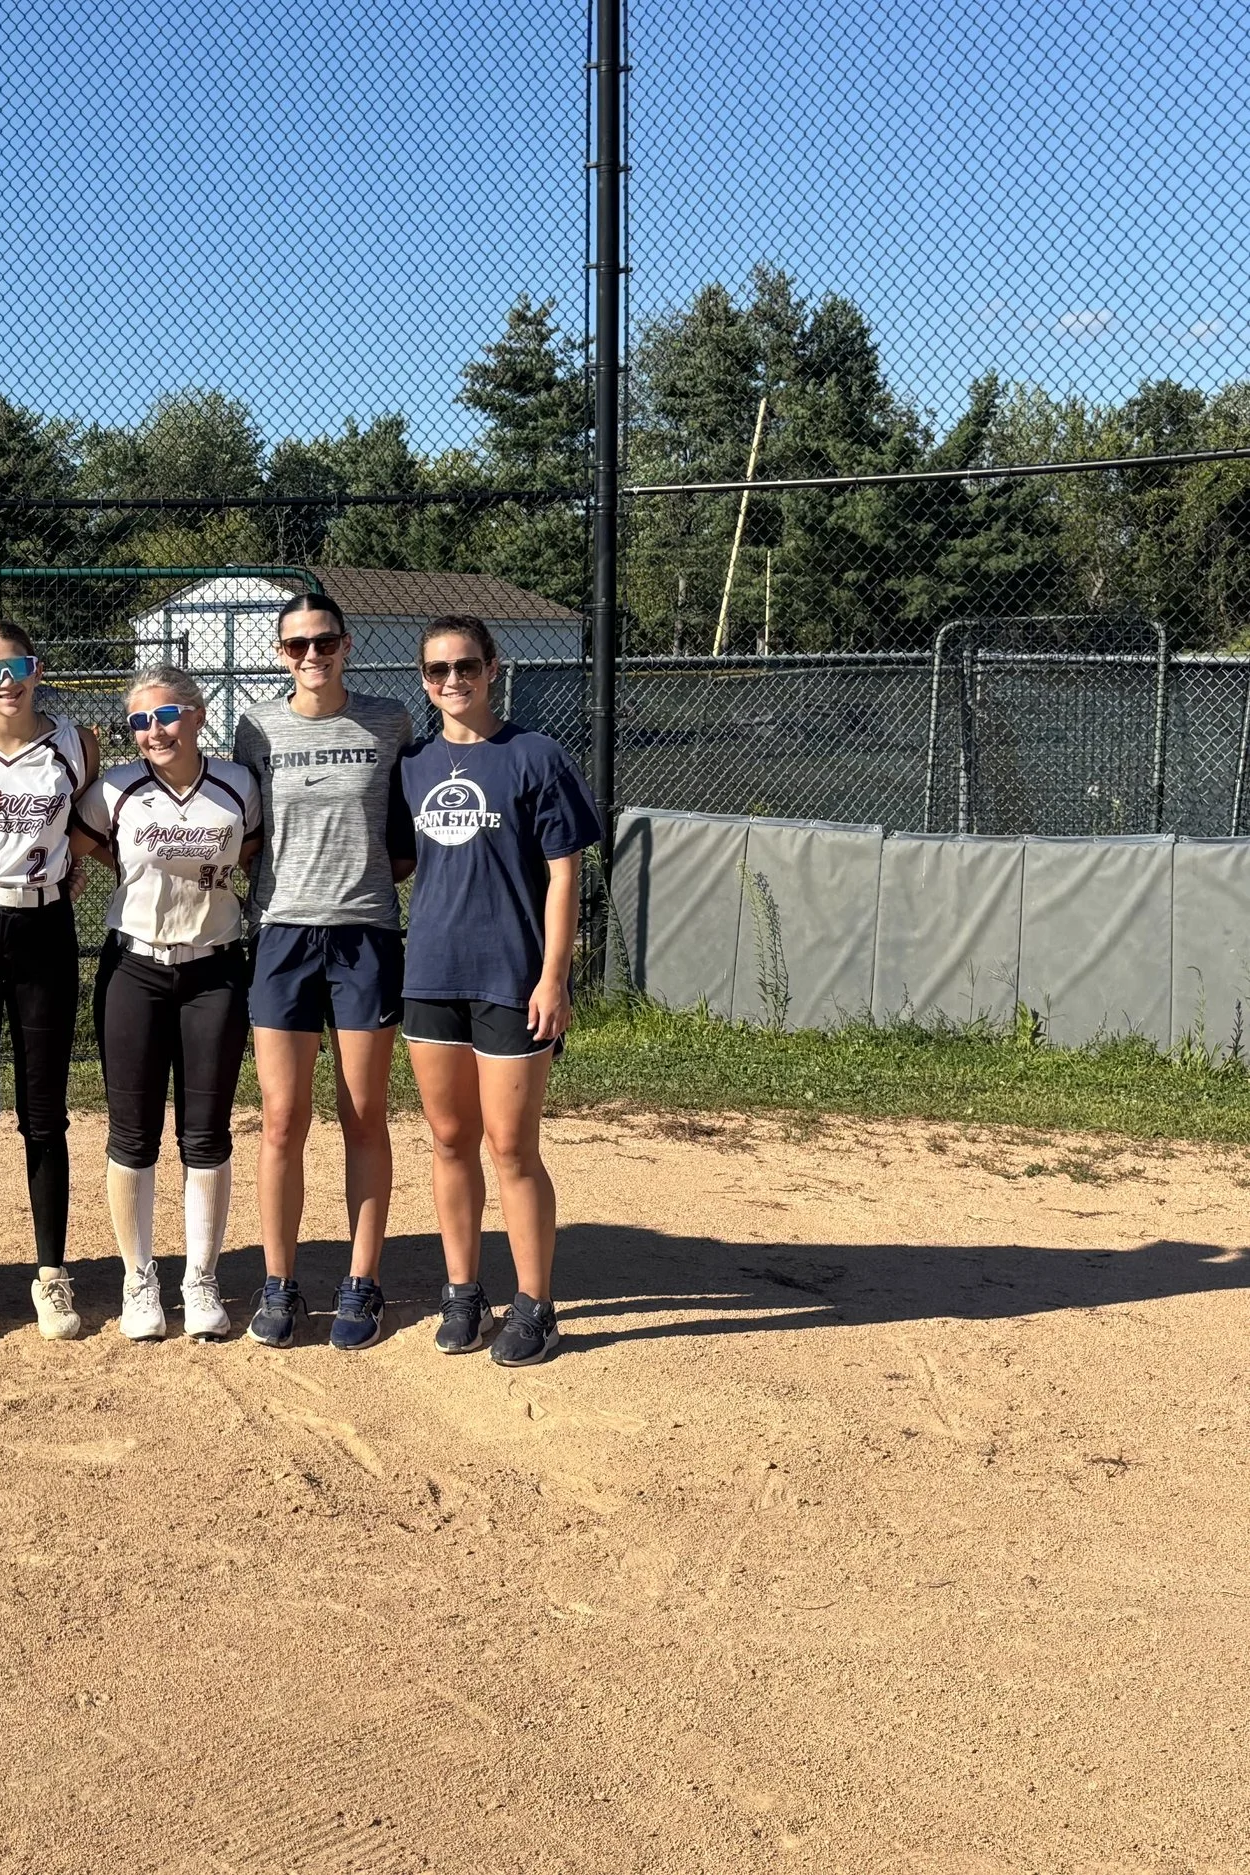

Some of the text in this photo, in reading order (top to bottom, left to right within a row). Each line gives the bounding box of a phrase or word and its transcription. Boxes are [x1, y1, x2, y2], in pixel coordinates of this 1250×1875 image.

[262, 748, 378, 771] PENN STATE
[413, 811, 501, 832] PENN STATE
[134, 822, 233, 852] VANQUISH
[26, 846, 48, 884] 2
